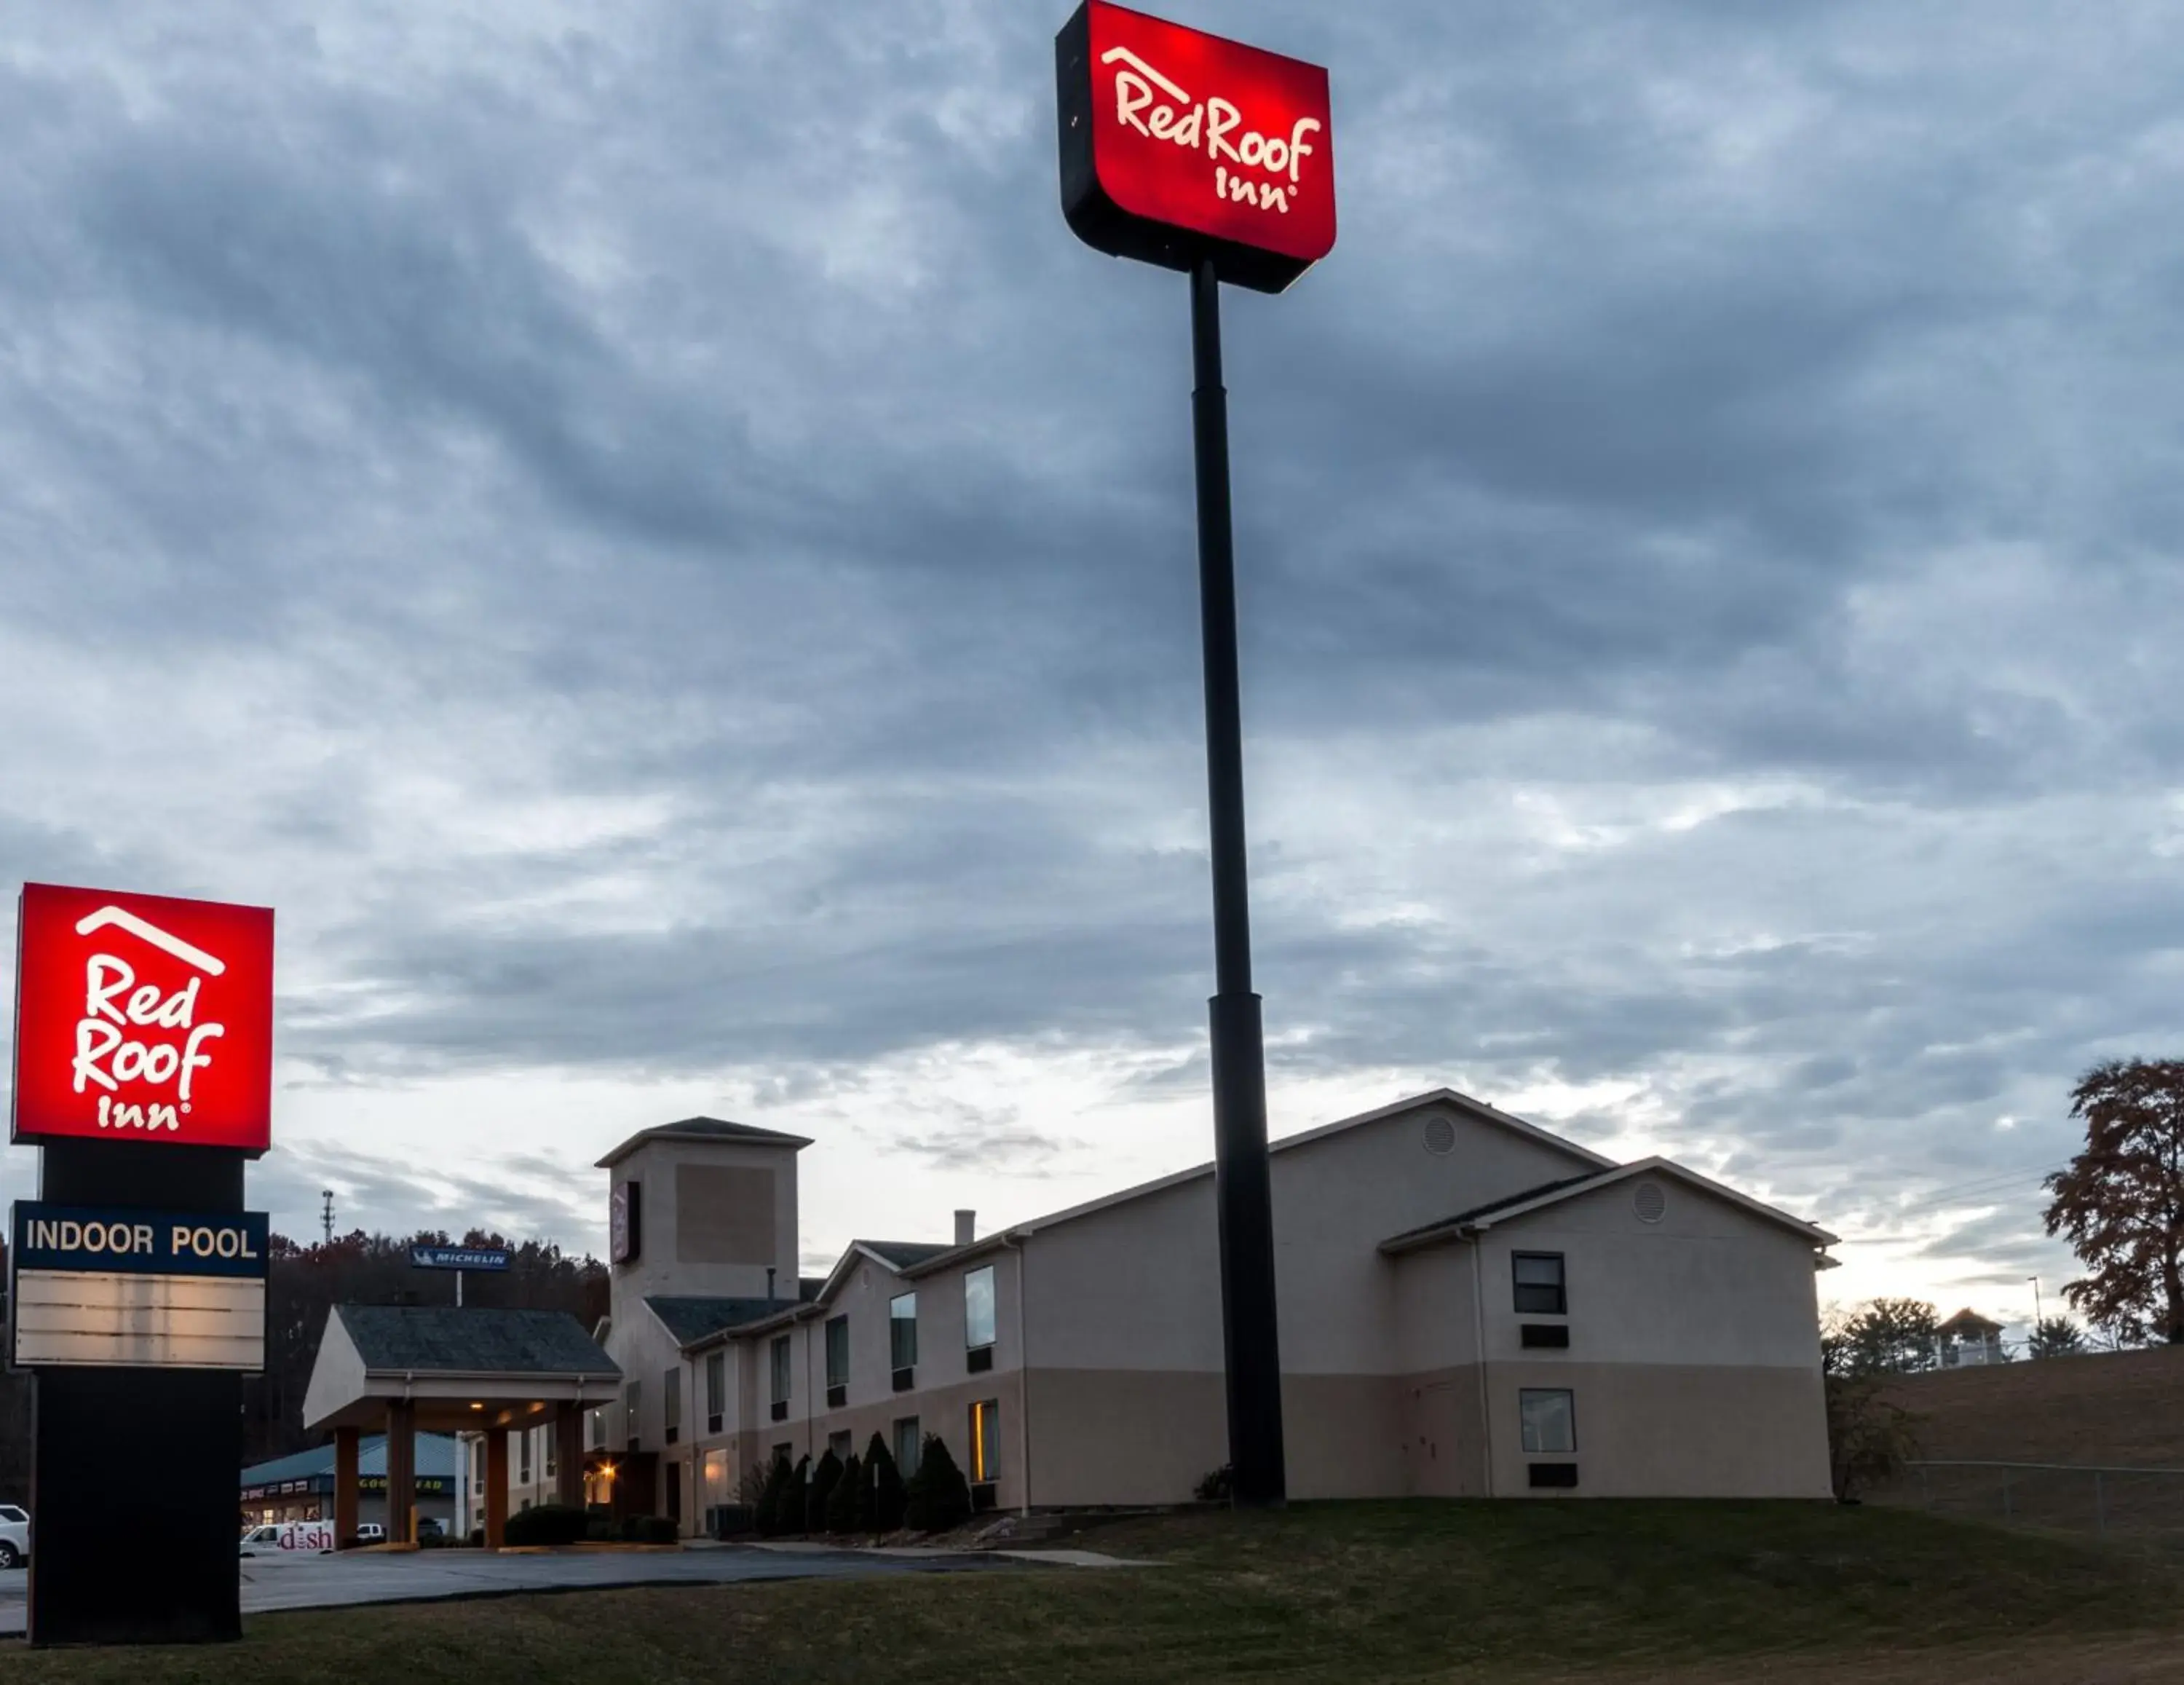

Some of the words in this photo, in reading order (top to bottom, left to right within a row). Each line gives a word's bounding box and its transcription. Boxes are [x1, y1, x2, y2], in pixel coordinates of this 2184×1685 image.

[86, 953, 201, 1029] Red
[71, 1017, 225, 1101] Roof
[26, 1219, 154, 1255] INDOOR
[172, 1226, 258, 1258] POOL
[436, 1252, 506, 1264] MICHELIN
[280, 1526, 332, 1550] dish
